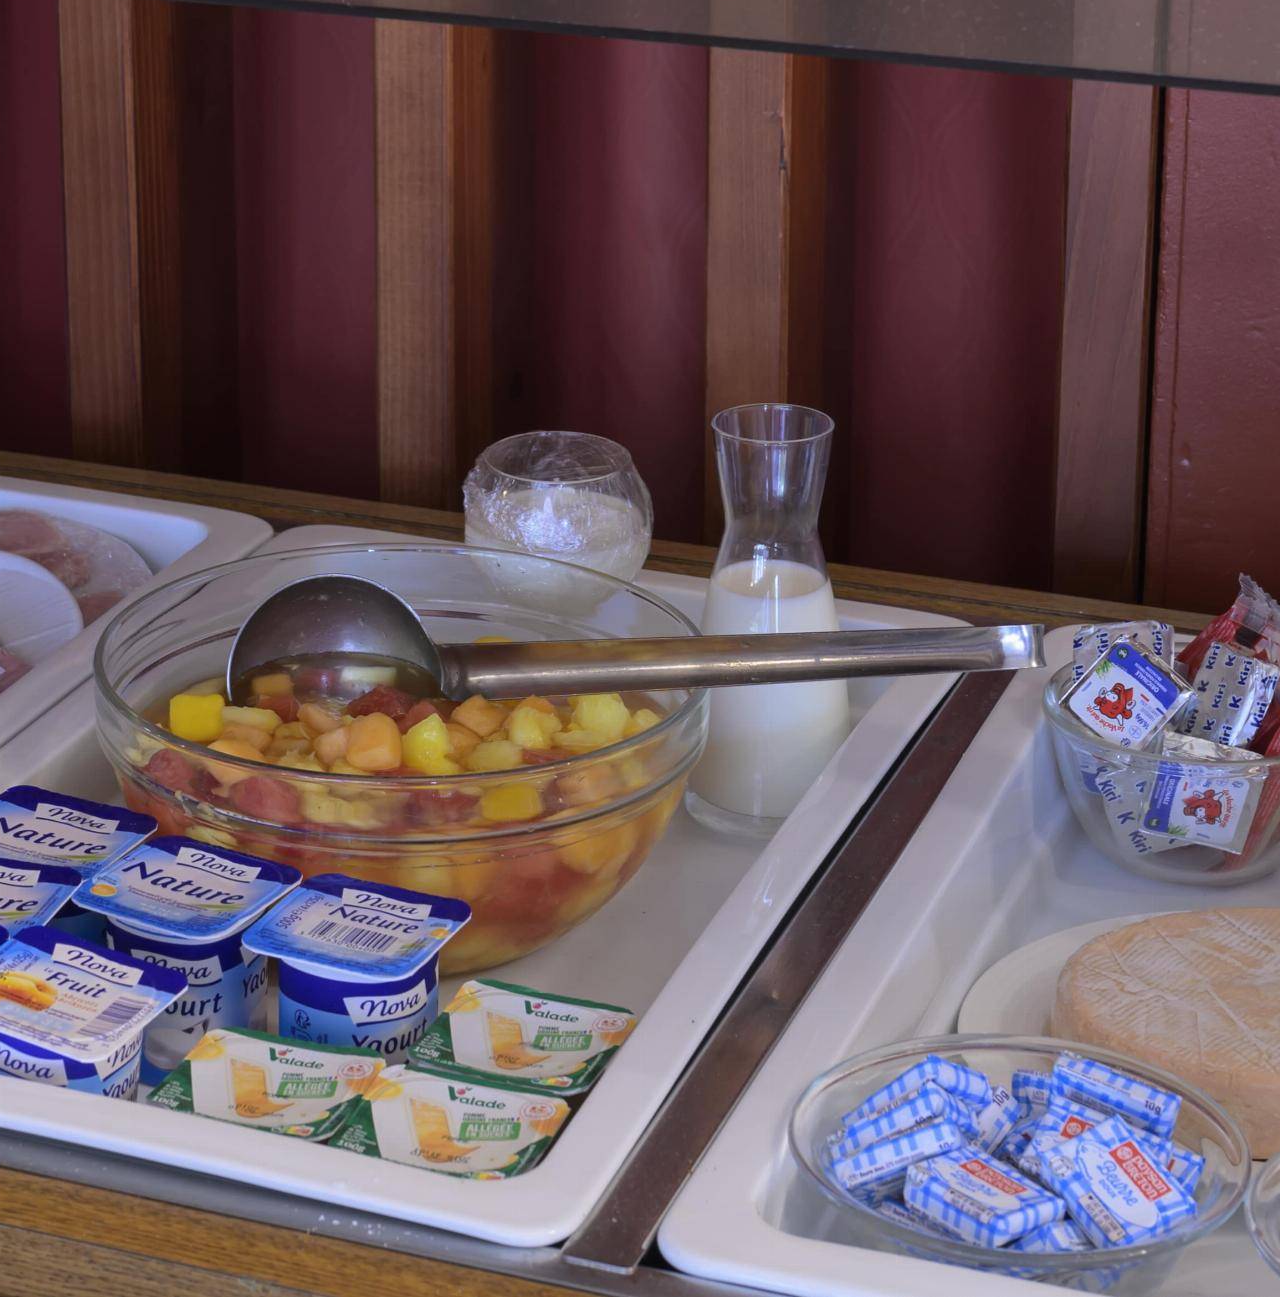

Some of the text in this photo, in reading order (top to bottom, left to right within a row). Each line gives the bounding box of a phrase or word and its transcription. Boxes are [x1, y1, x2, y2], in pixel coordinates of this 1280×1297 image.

[1205, 643, 1220, 669] Kiri
[1225, 655, 1236, 666] K
[1072, 665, 1084, 684] iri
[1238, 660, 1253, 685] Kiri
[1212, 683, 1226, 709] Kiri
[1228, 696, 1242, 709] K
[1184, 709, 1198, 733] Kiri
[1251, 702, 1267, 728] Kiri
[1098, 780, 1120, 802] Kiri
[48, 806, 107, 830] Nova
[1117, 811, 1134, 824] K
[1129, 830, 1152, 853] Kiri
[190, 851, 248, 877] Nova
[121, 861, 245, 905] Nature
[356, 892, 419, 916] Nova
[328, 905, 420, 934] Nature
[67, 949, 128, 980] Nova
[46, 971, 109, 999] Fruit
[360, 991, 422, 1018] Nova
[524, 1001, 579, 1023] Valade
[269, 1047, 324, 1069] Valade
[448, 1086, 506, 1109] Valade
[992, 1089, 1009, 1107] 10g
[1144, 1100, 1162, 1115] 10g
[1096, 1160, 1138, 1207] Beurre
[1134, 1155, 1167, 1191] paysan
